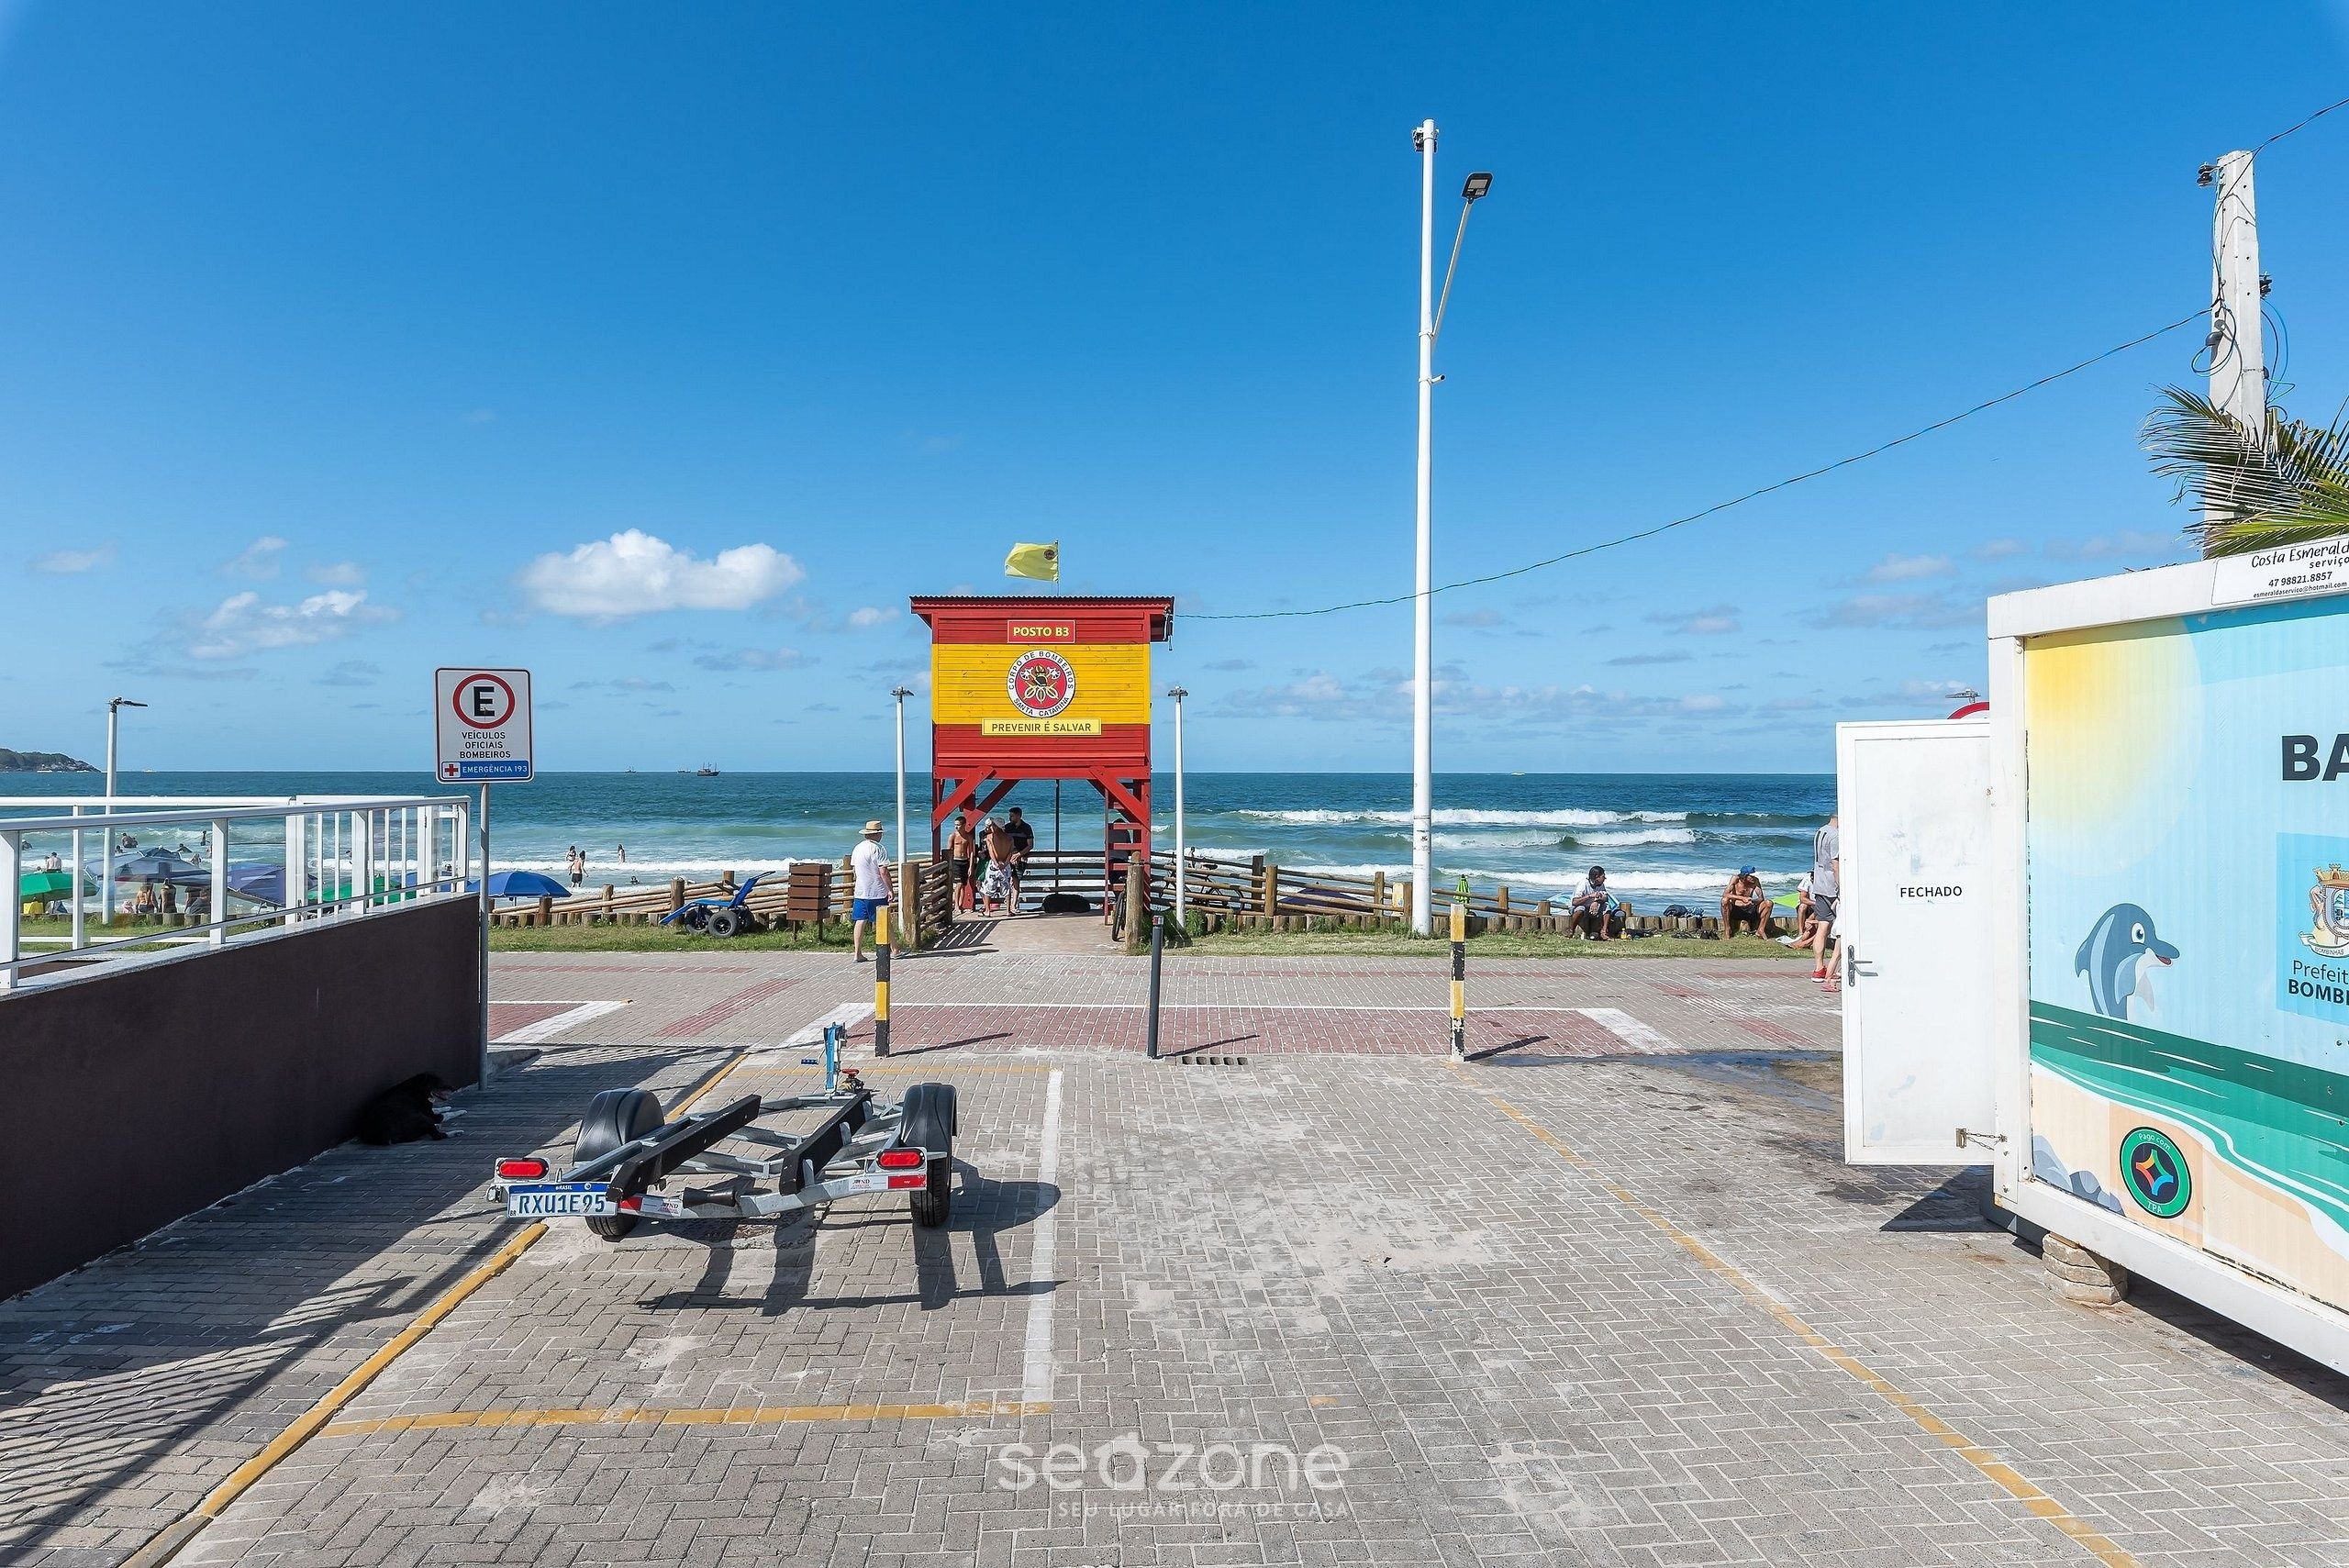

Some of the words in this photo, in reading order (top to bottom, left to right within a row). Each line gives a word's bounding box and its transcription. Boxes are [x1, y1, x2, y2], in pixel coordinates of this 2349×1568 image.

[2251, 551, 2286, 568] Costa
[2268, 579, 2279, 587] 47
[2280, 571, 2332, 585] 98821.8857
[1013, 627, 1052, 637] POSTO
[1055, 627, 1069, 637] B3
[1008, 660, 1023, 690] CORPO
[1023, 651, 1036, 662] DE
[1039, 651, 1074, 689] BOMBEIROS
[473, 685, 495, 717] E
[1013, 697, 1033, 715] SANTA
[1038, 696, 1070, 717] CATARINA
[991, 723, 1041, 732] PREVENIR
[1044, 721, 1051, 732] É
[1053, 723, 1092, 732] SALVAR
[461, 730, 506, 740] VEÍCULOS
[460, 751, 511, 759] BOMBEIROS
[462, 764, 513, 773] EMERGÊNCIA
[1899, 885, 1963, 897] FECHADO
[2293, 960, 2349, 985] Prefeit
[2155, 1137, 2171, 1151] com
[518, 1194, 606, 1214] RXU1E95
[2147, 1201, 2164, 1214] TPA
